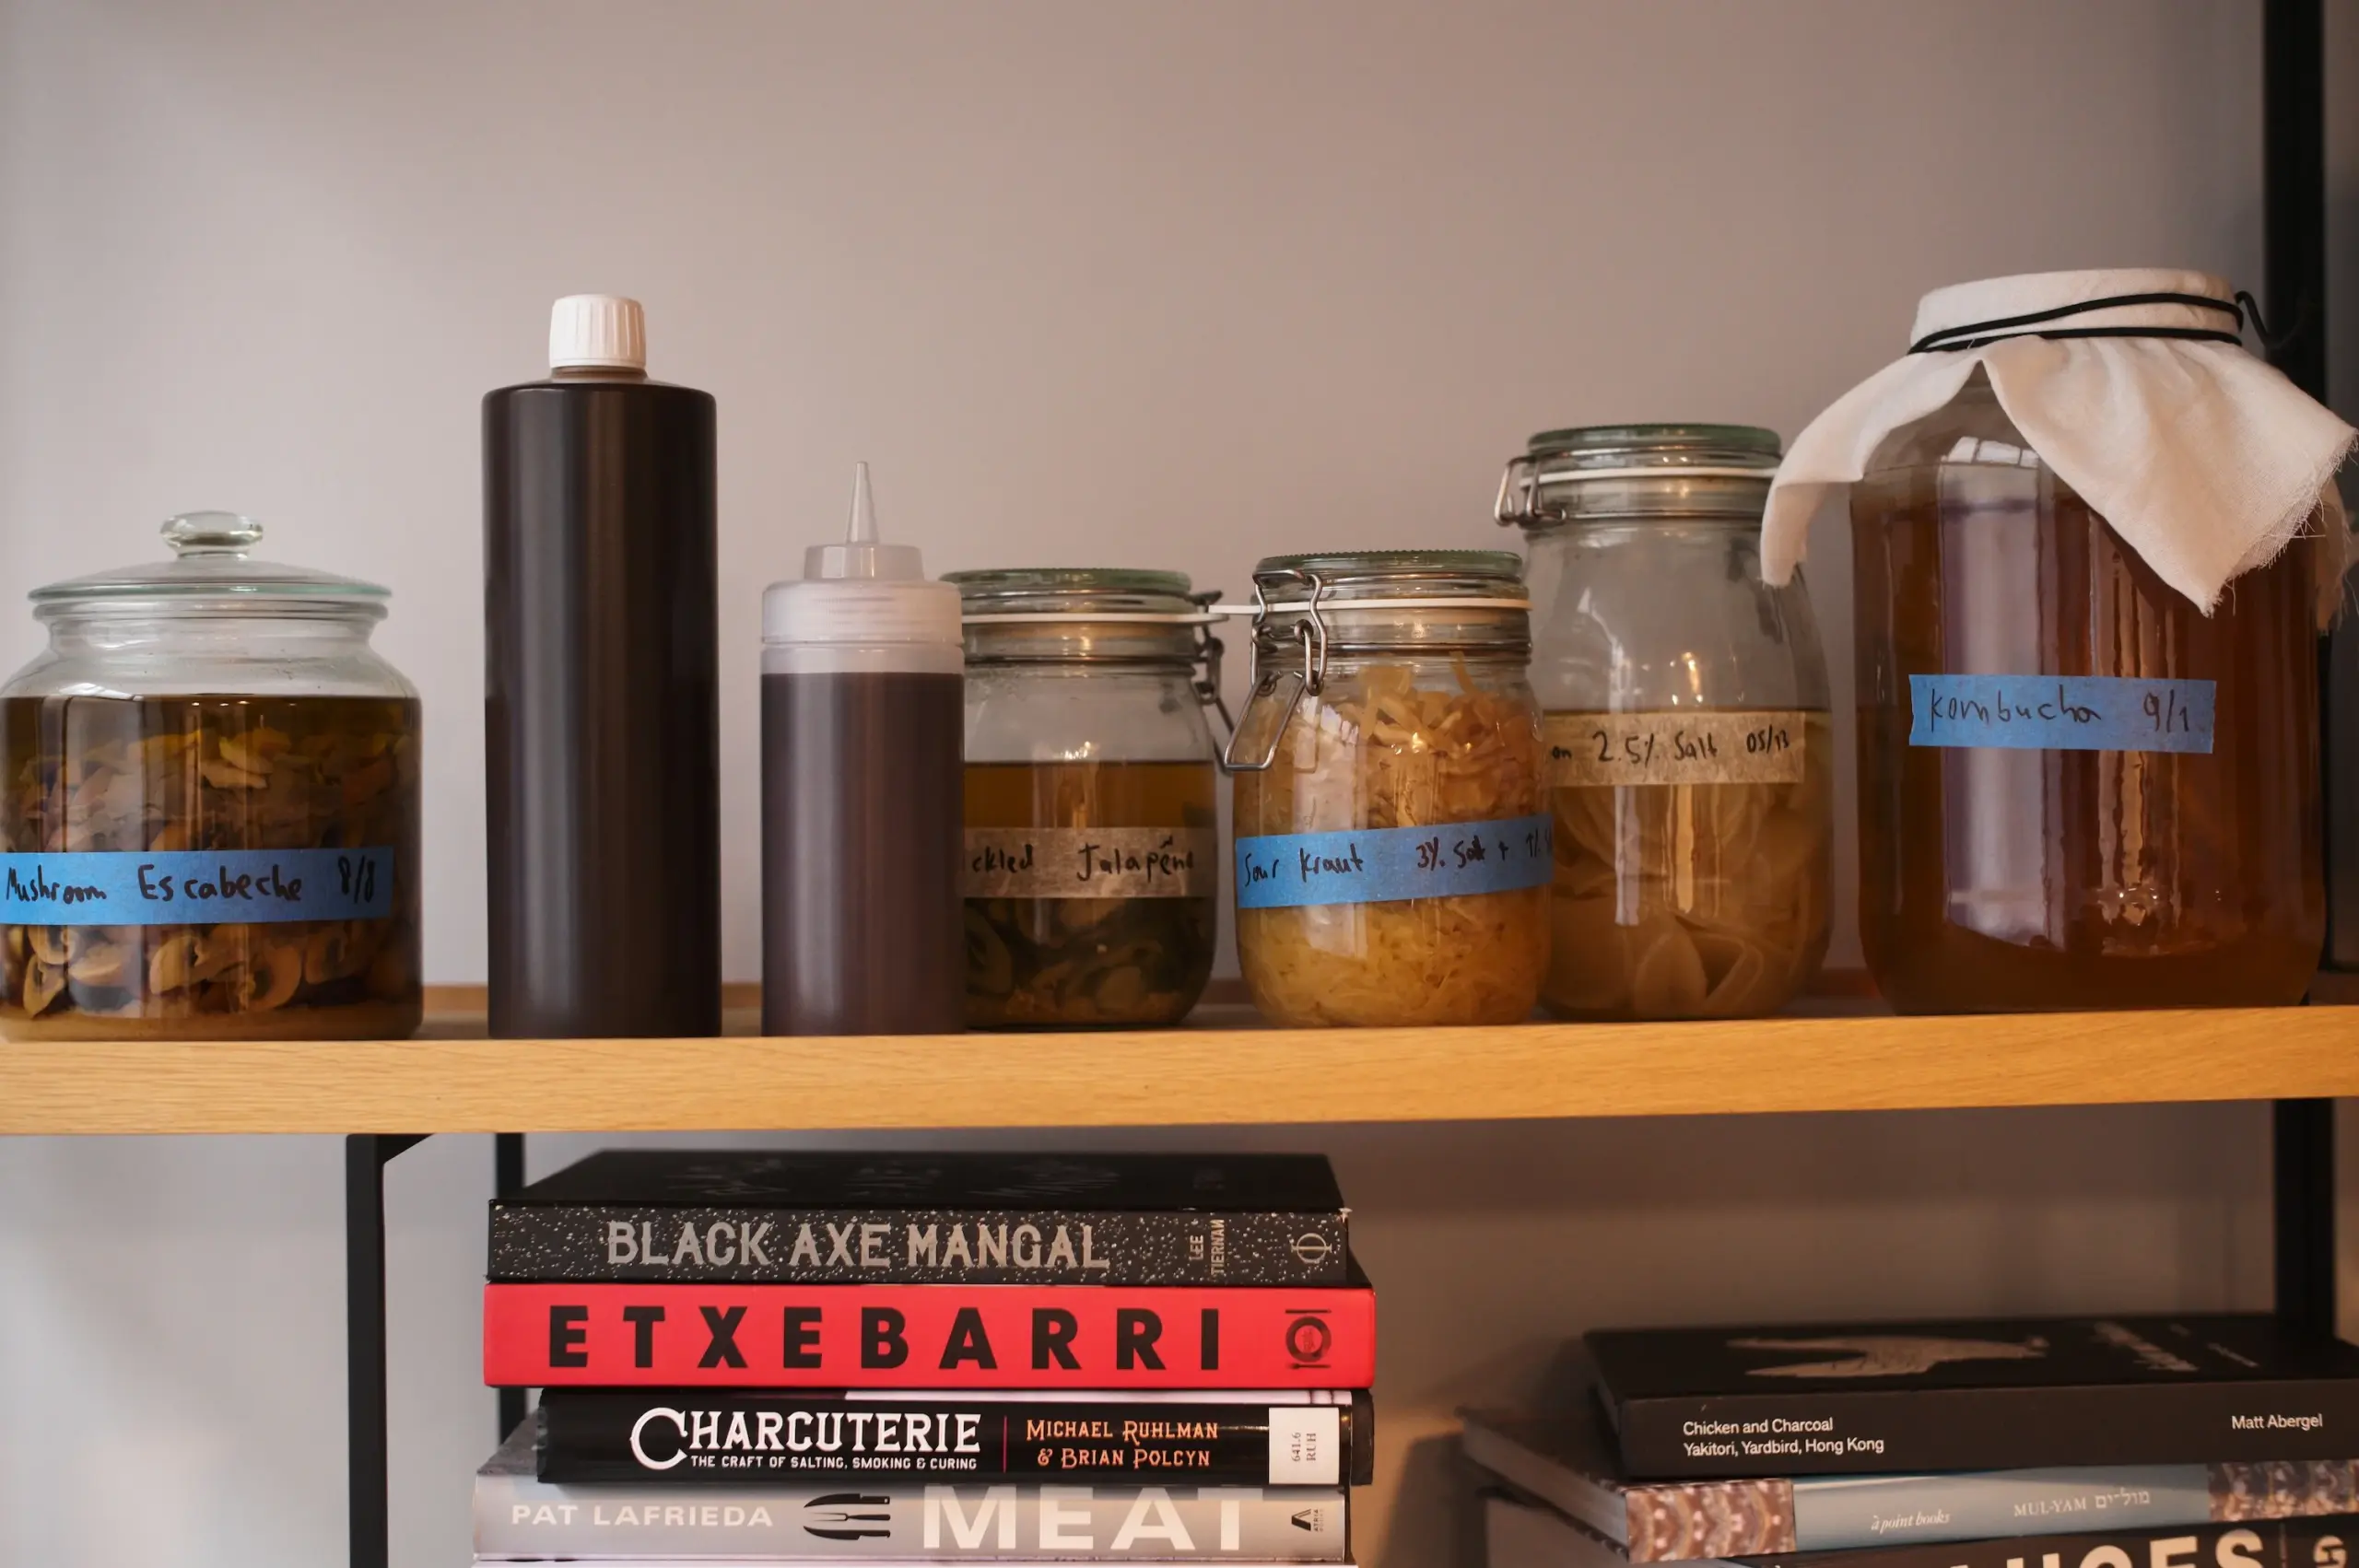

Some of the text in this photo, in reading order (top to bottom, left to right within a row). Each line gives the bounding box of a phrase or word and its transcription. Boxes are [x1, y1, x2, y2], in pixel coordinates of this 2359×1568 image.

[1673, 730, 1719, 763] Salt
[971, 844, 1034, 873] ckled
[6, 864, 108, 905] Mushroom
[606, 1221, 1111, 1270] BLACK AXE MANGAL
[1189, 1235, 1204, 1261] LEE
[1210, 1219, 1226, 1276] TIERNAN
[548, 1305, 1220, 1370] ETXEBARRI
[1026, 1419, 1219, 1445] MICHAEL RUHLMAN
[1683, 1417, 1834, 1436] Chicken and Charcoal
[2231, 1413, 2324, 1431] Matt Abergel
[629, 1407, 981, 1470] CHARCUTERIE
[1291, 1432, 1301, 1463] 641.6
[1306, 1433, 1317, 1462] RUH
[1684, 1436, 1885, 1457] Yakitori, Yardbird, Hong Kong
[691, 1456, 978, 1470] THE CRAFT OF SALTING, SMOKING & CURING
[1037, 1447, 1212, 1469] & BRIAN POLCYN
[511, 1504, 774, 1527] PAT LAFRIEDA
[923, 1485, 1263, 1551] MEAT
[2013, 1497, 2087, 1517] MUL-YAM
[1879, 1513, 1914, 1534] point
[1916, 1509, 1951, 1526] books
